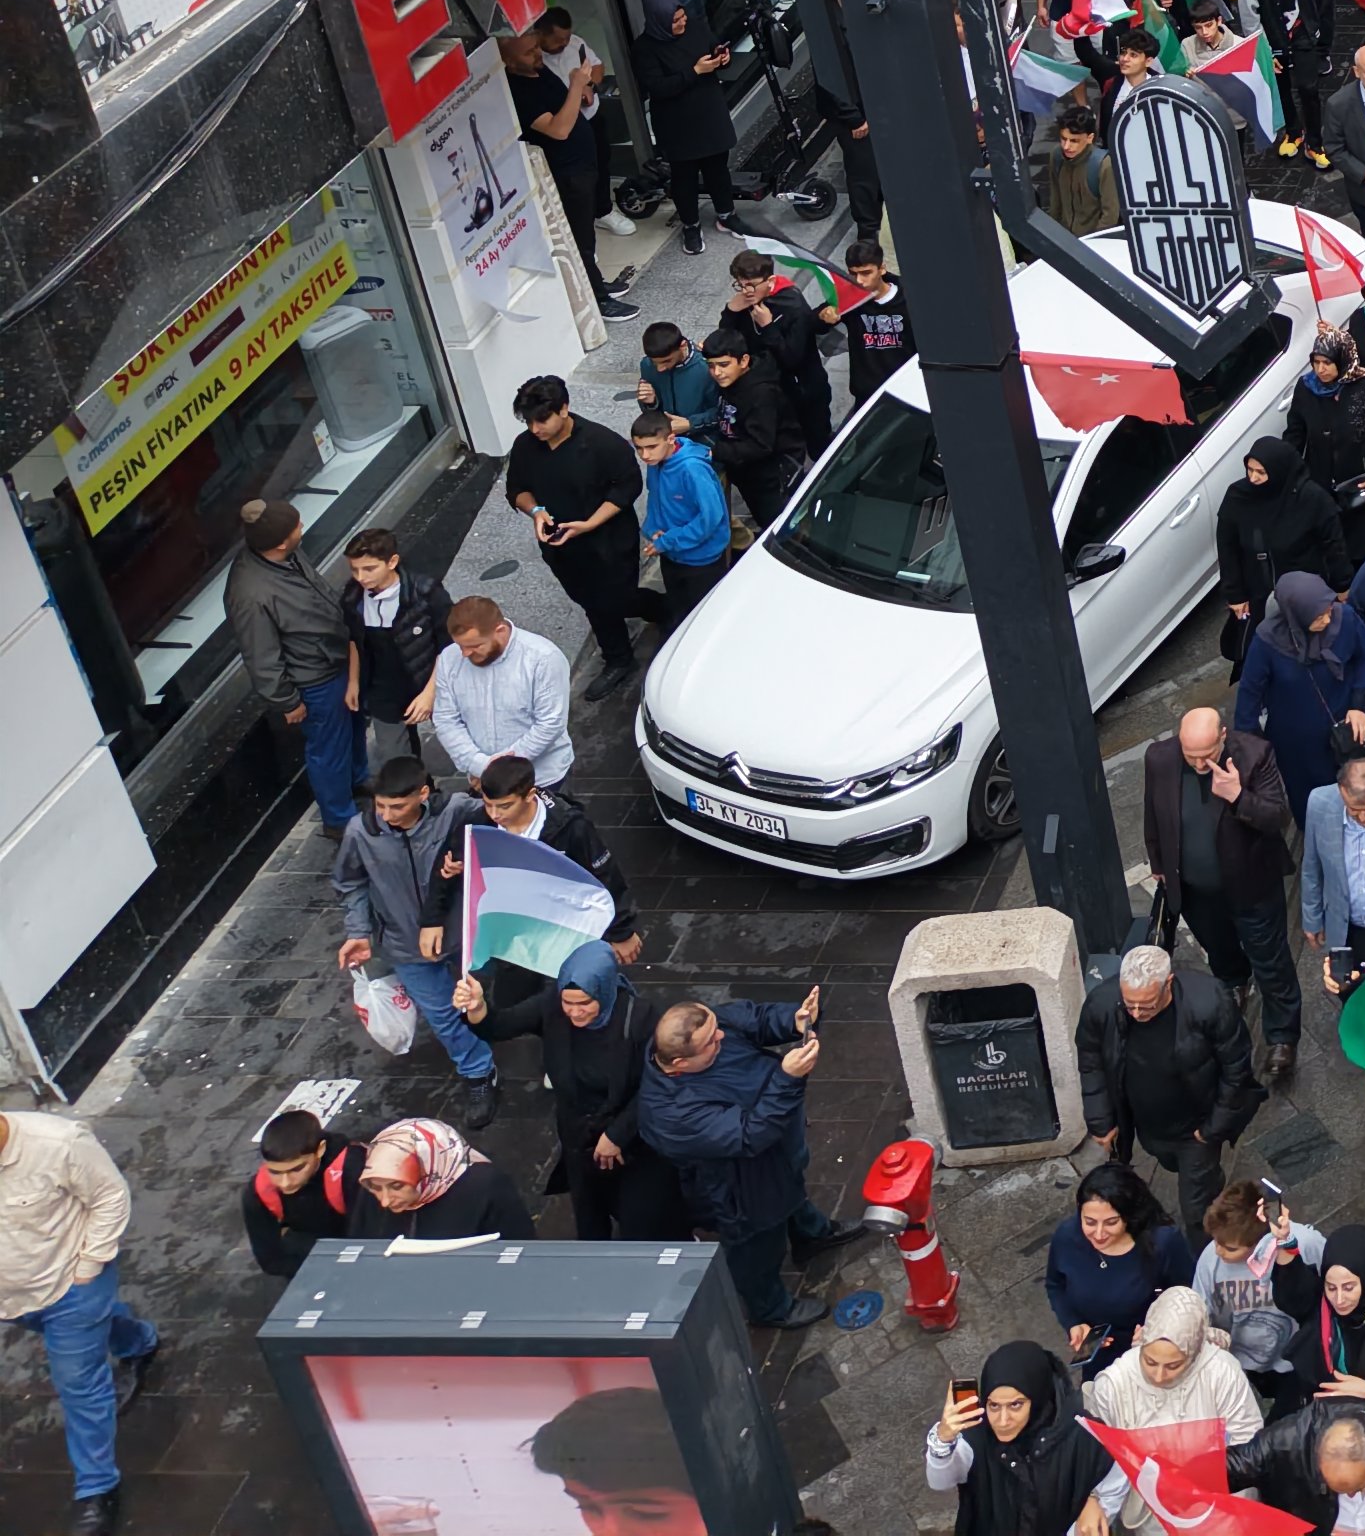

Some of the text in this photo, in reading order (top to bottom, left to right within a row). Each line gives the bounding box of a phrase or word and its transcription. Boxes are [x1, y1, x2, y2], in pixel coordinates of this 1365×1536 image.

[430, 127, 455, 153] dyson
[475, 218, 528, 277] 24 Ay Taksitle
[166, 229, 285, 345] KAMPANYA
[89, 452, 147, 514] PEŞİN
[146, 377, 227, 461] FİYATINA
[228, 357, 243, 381] 9
[246, 331, 268, 368] AY
[268, 255, 348, 340] TAKSİTLE
[696, 795, 714, 815] 34
[744, 813, 782, 836] 2034
